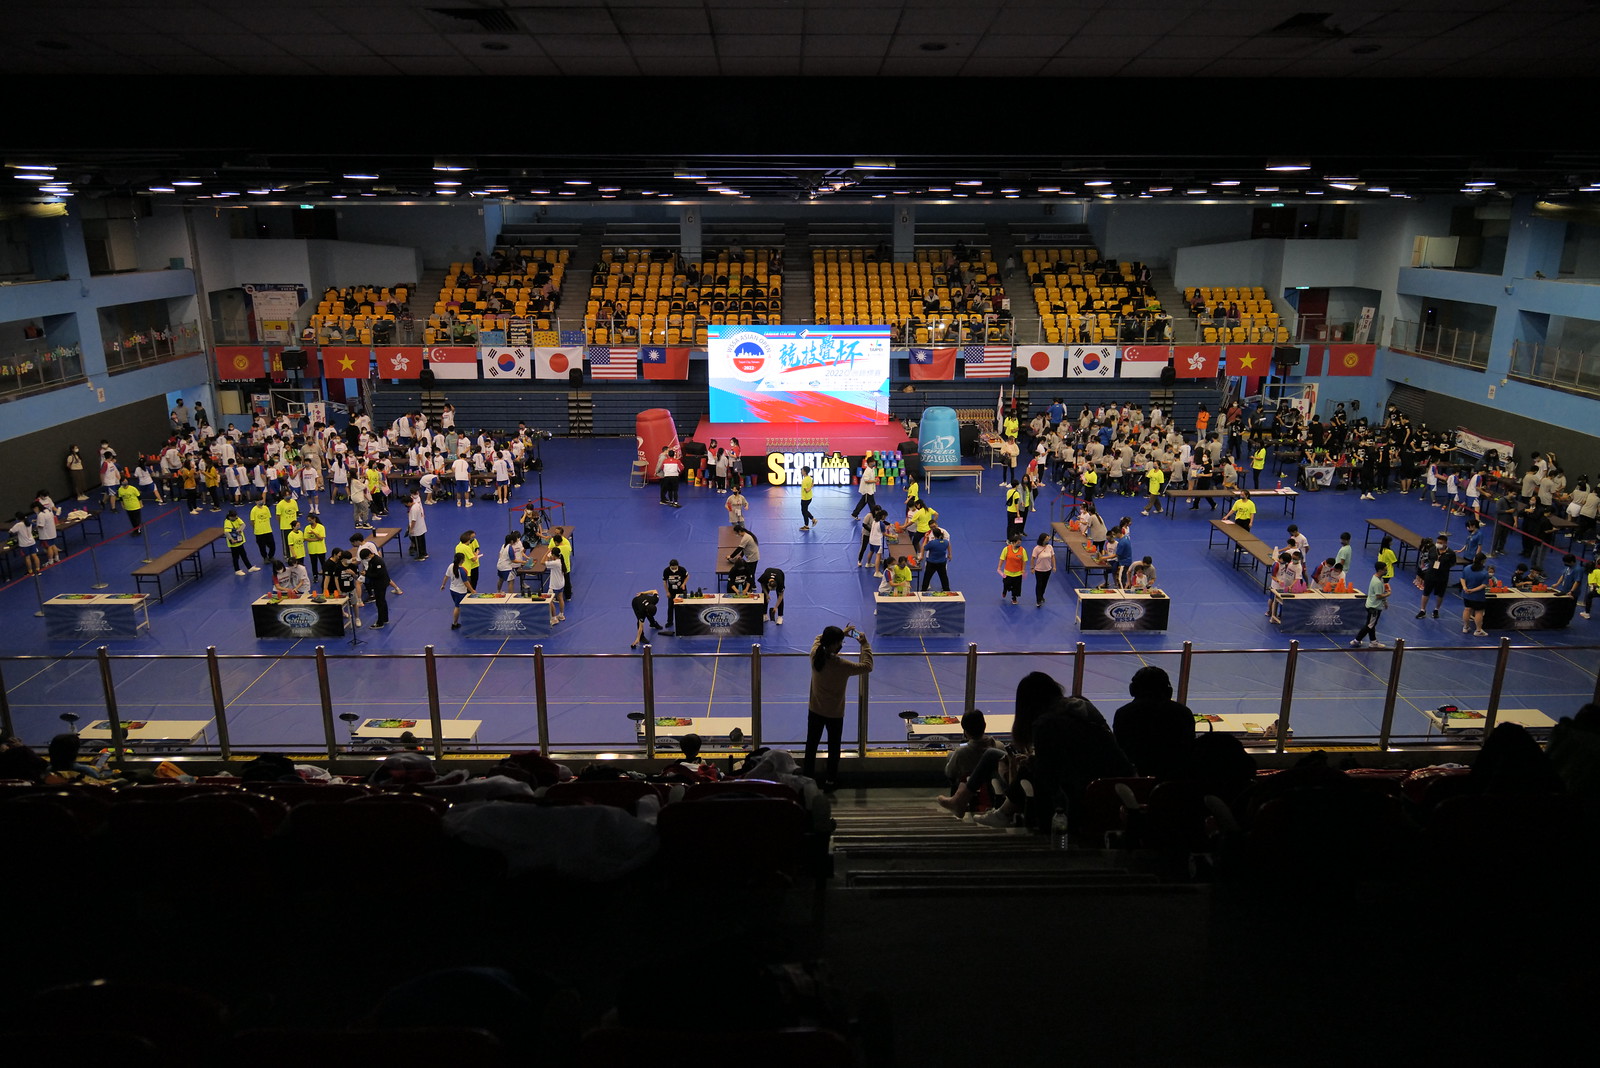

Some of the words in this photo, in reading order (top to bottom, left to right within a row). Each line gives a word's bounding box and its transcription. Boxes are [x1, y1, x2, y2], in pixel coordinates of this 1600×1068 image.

[726, 338, 741, 353] WSSA
[740, 333, 758, 341] ASIAN
[758, 338, 772, 353] OPEN
